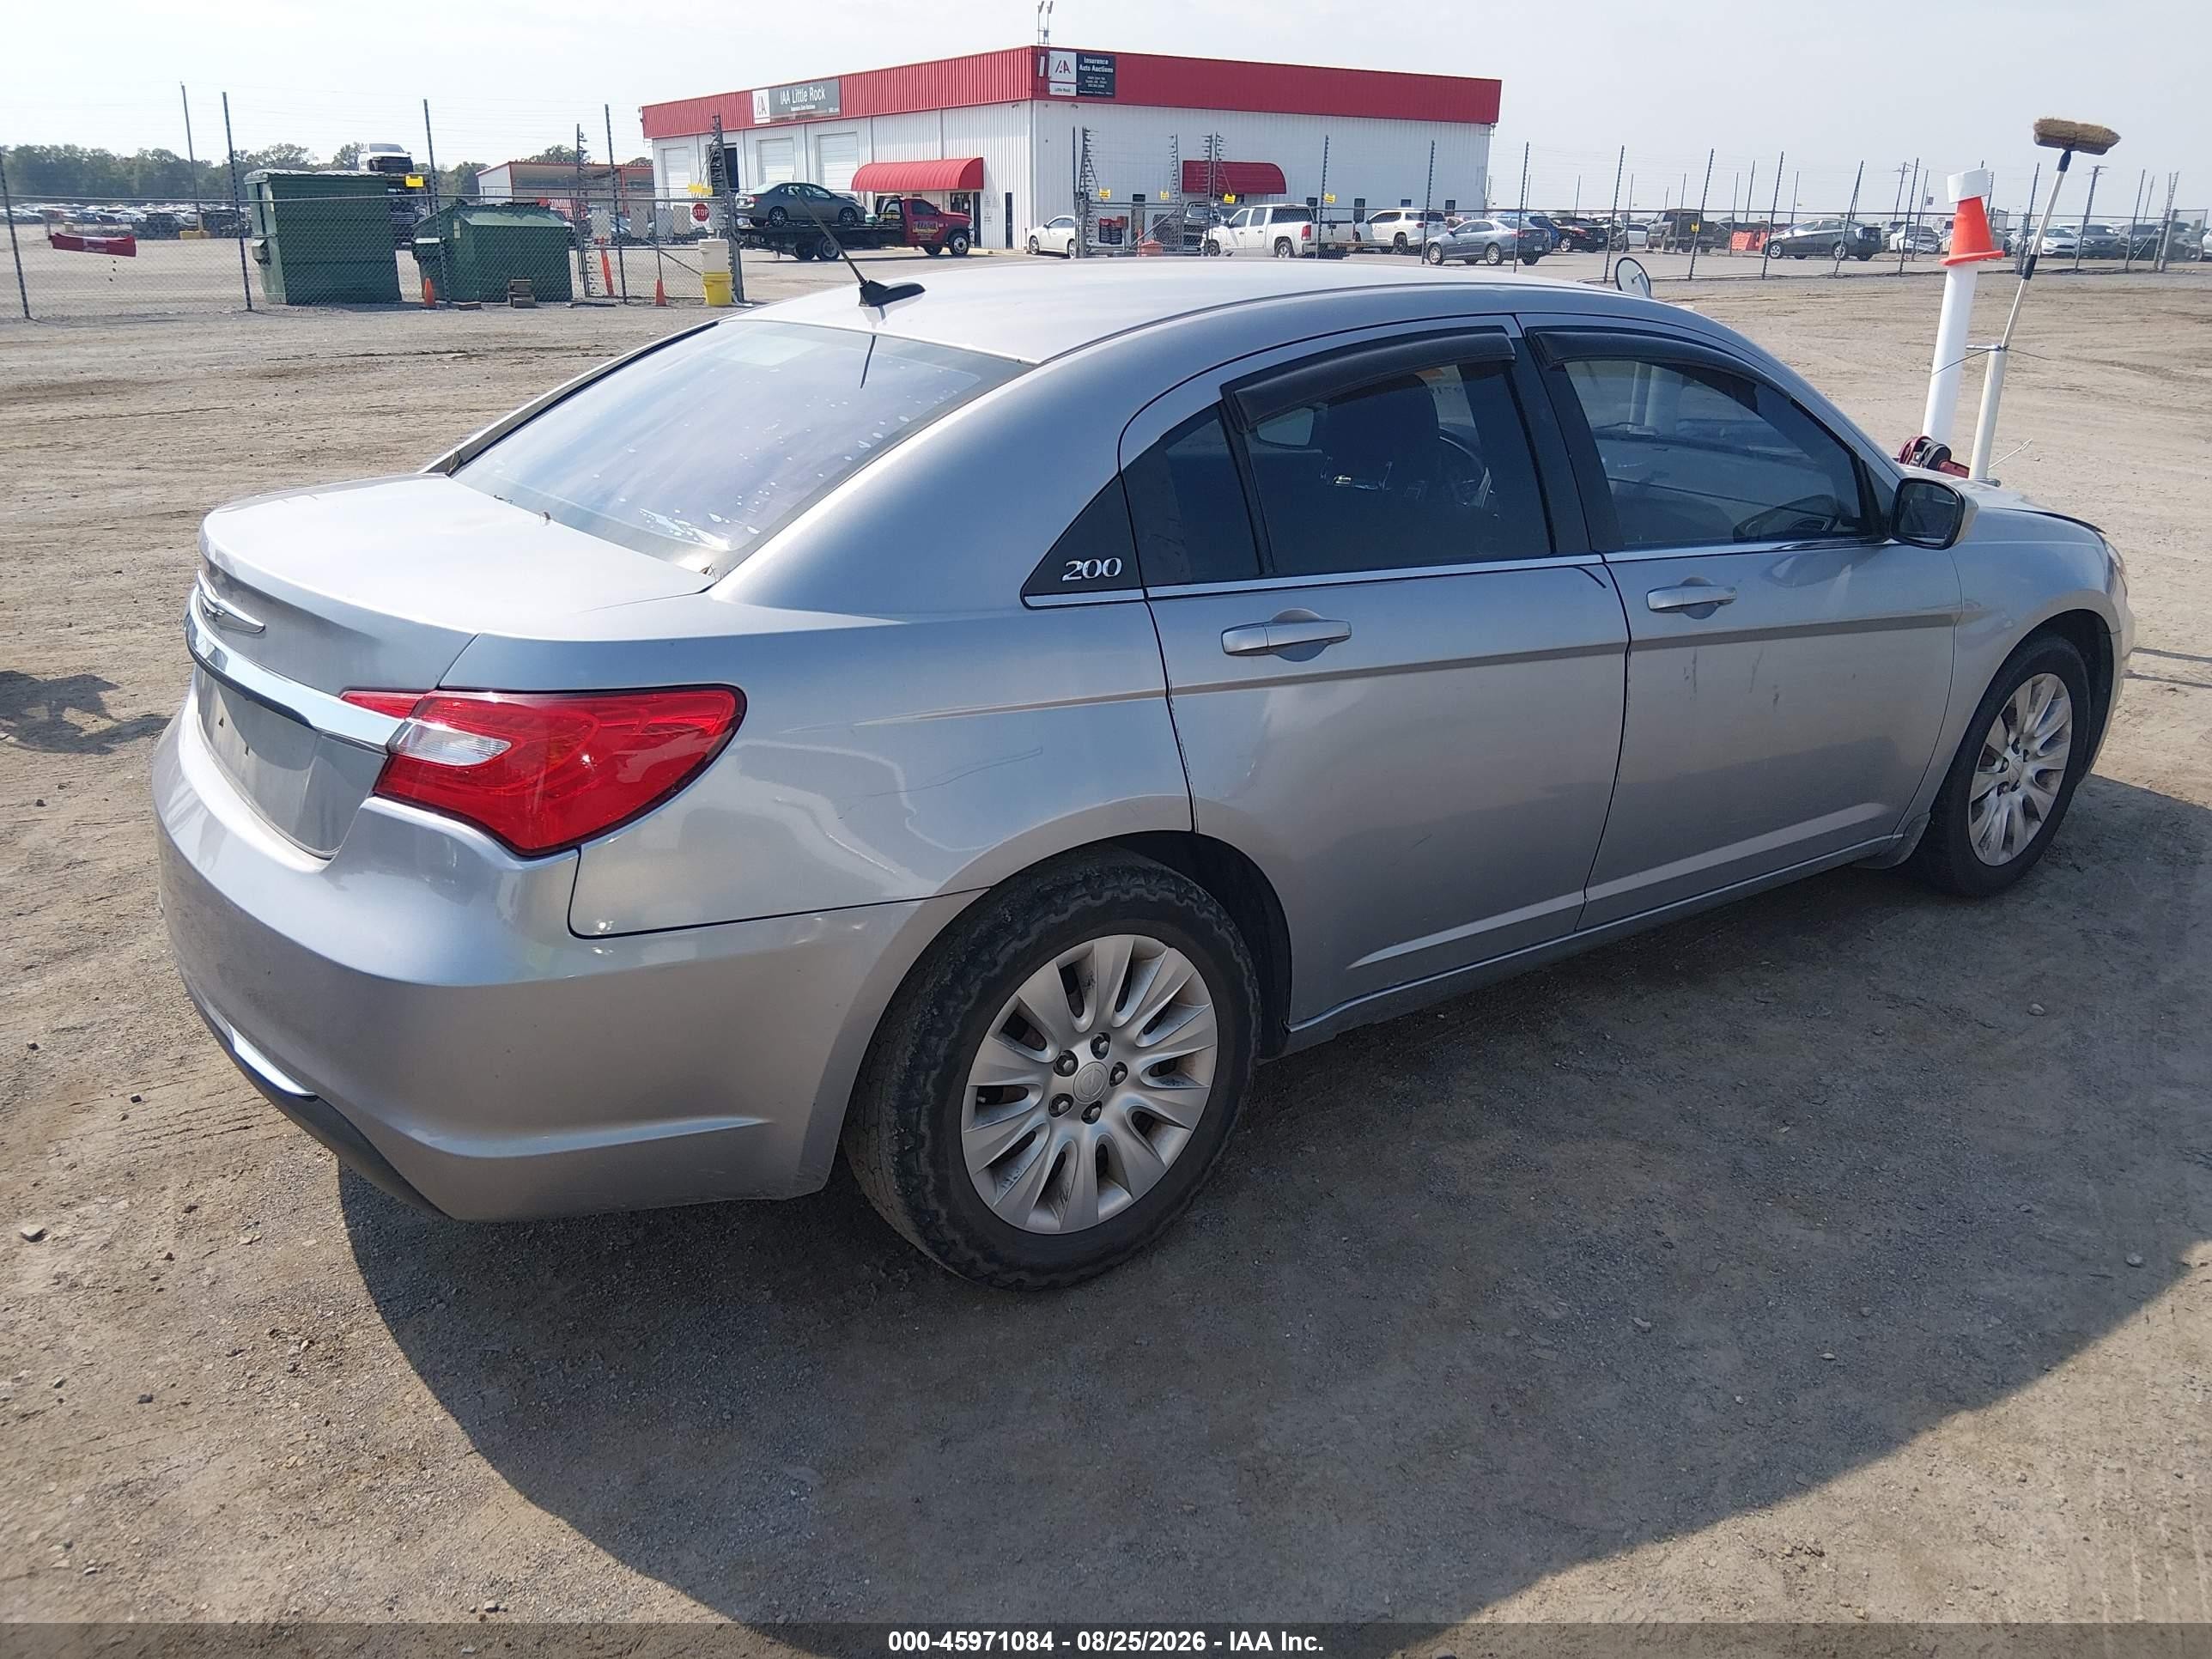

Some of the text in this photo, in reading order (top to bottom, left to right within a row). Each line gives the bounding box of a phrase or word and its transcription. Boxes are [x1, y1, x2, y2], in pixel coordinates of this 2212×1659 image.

[780, 85, 826, 105] IAA Little Rock
[1061, 557, 1122, 581] 200
